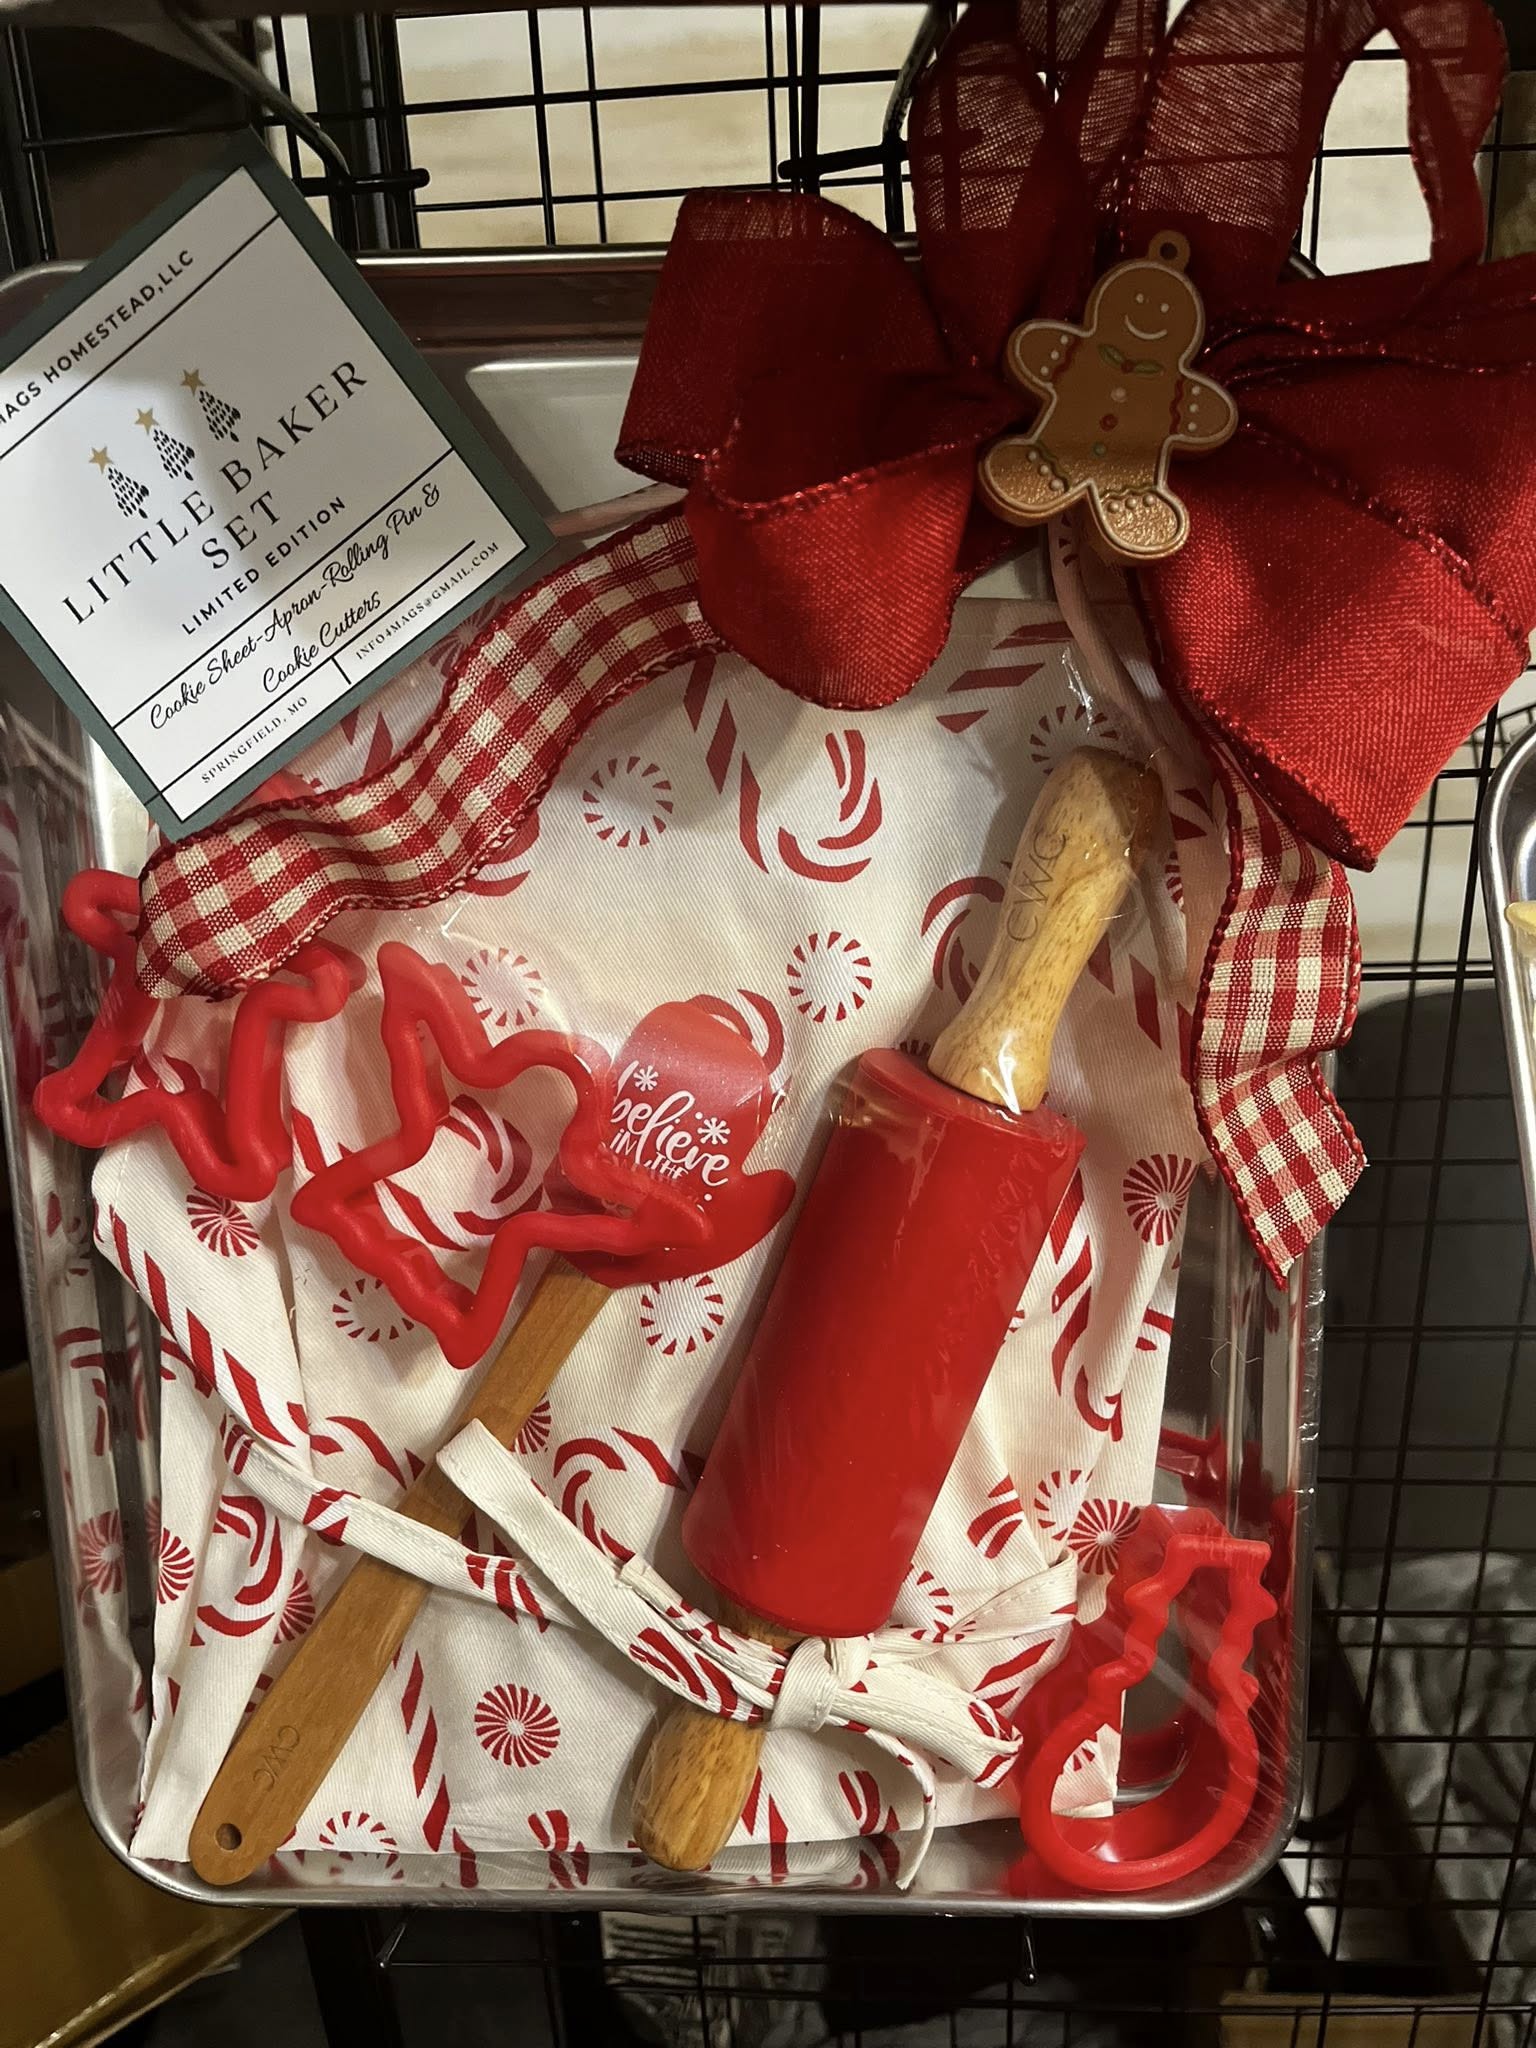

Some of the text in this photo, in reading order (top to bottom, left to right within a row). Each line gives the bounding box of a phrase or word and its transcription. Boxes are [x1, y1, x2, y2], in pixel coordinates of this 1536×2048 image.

[43, 250, 194, 384] HOMESTEAD,LLC
[62, 361, 368, 625] LITTLE BAKER
[201, 491, 281, 570] SET
[150, 682, 206, 730] Cookie
[386, 506, 422, 535] Pin
[423, 483, 441, 508] &
[181, 496, 346, 635] LIMITED EDITION
[355, 542, 499, 660] INFO4MAGS@GMAIL.COM
[262, 591, 382, 693] Cookie Cutters
[201, 696, 309, 784] SPRINGFIELD, MO
